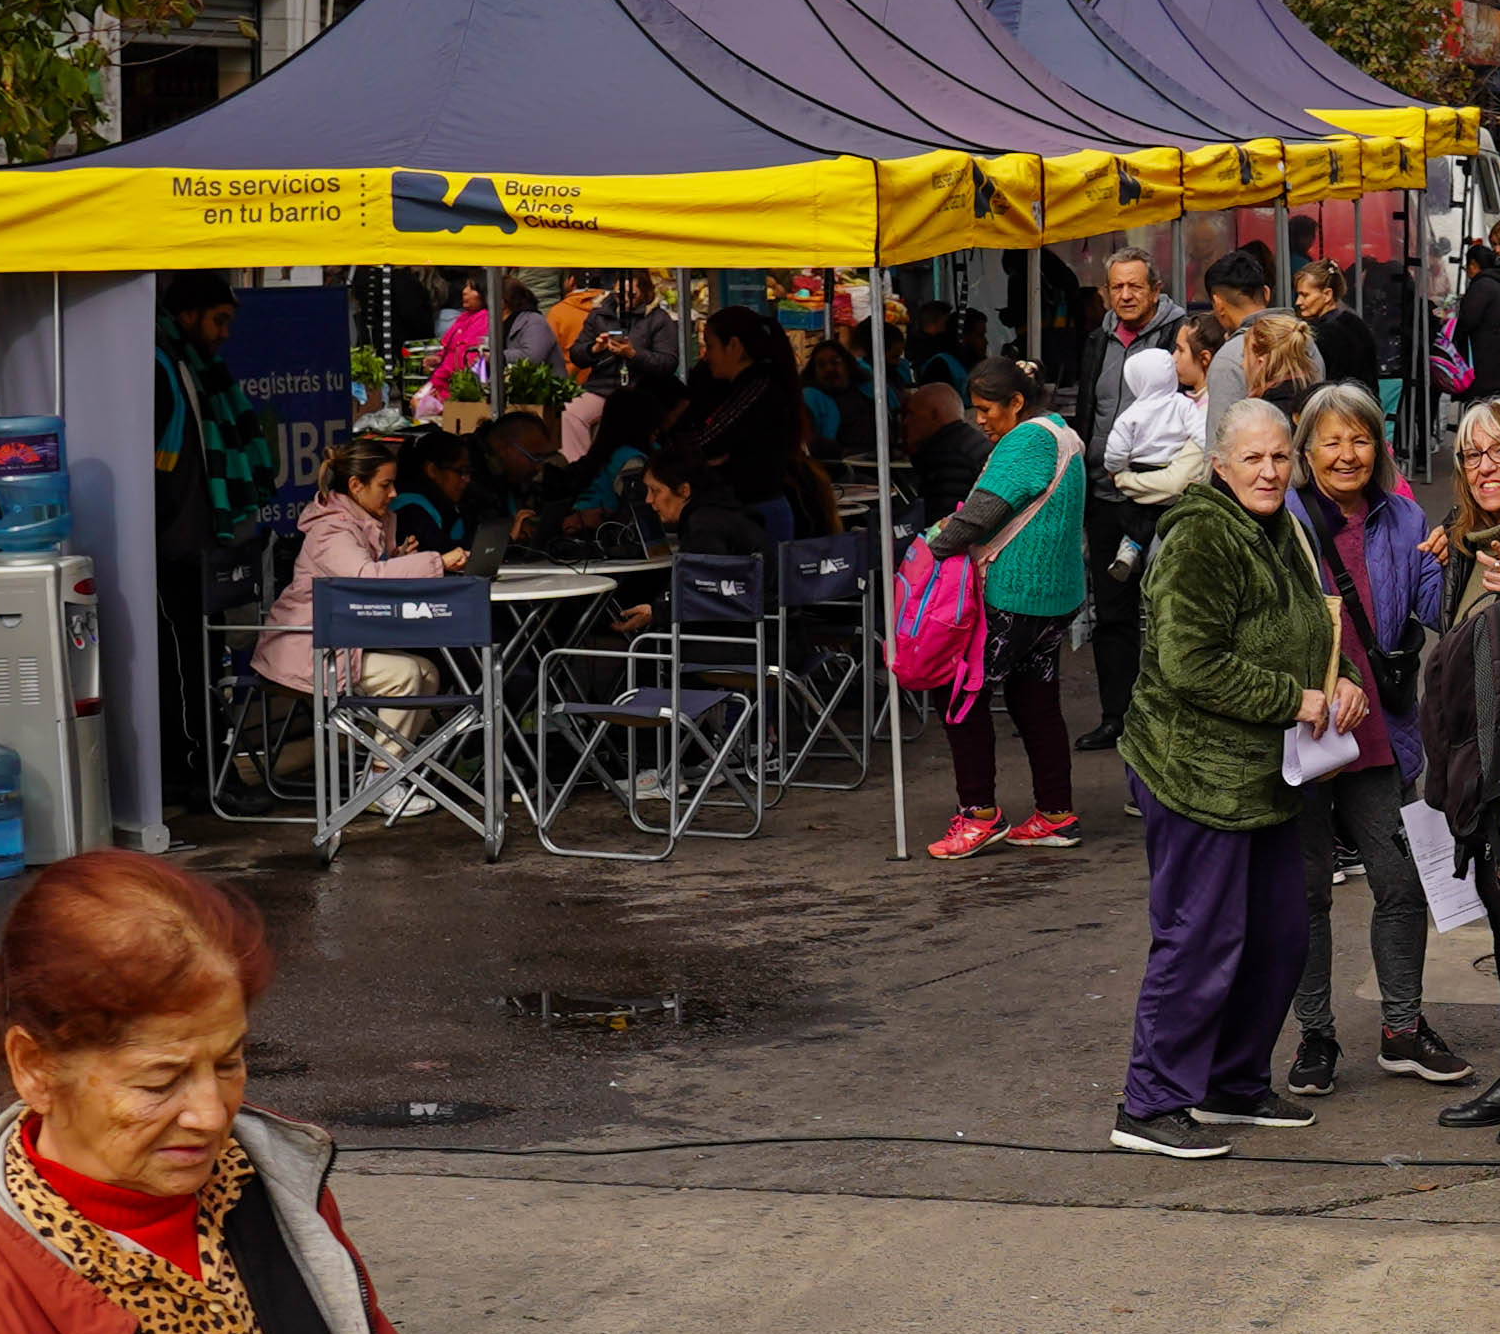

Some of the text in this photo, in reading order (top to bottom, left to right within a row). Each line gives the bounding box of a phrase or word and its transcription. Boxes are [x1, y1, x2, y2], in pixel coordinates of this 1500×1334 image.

[172, 175, 341, 197] Más servicios
[505, 181, 581, 197] Buenos
[391, 171, 518, 234] BA
[515, 199, 574, 214] Aires
[203, 201, 341, 225] en tu barrio
[523, 214, 598, 232] Ciudad
[239, 370, 344, 399] registrás tu
[402, 602, 433, 619] BA
